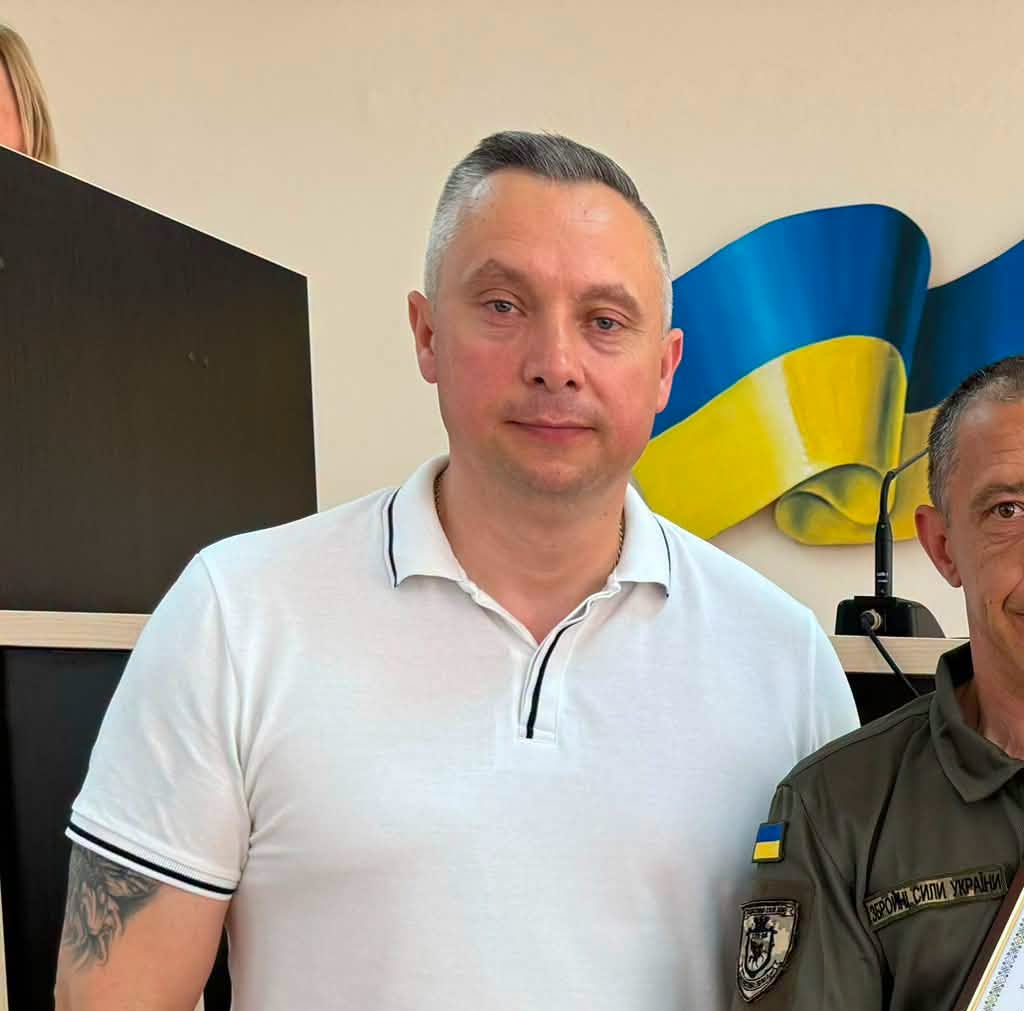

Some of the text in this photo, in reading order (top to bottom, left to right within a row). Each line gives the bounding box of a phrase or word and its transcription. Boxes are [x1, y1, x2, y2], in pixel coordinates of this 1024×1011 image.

[870, 871, 1002, 922] ЗБРОЙНІ СИЛИ УКРАЇНИ
